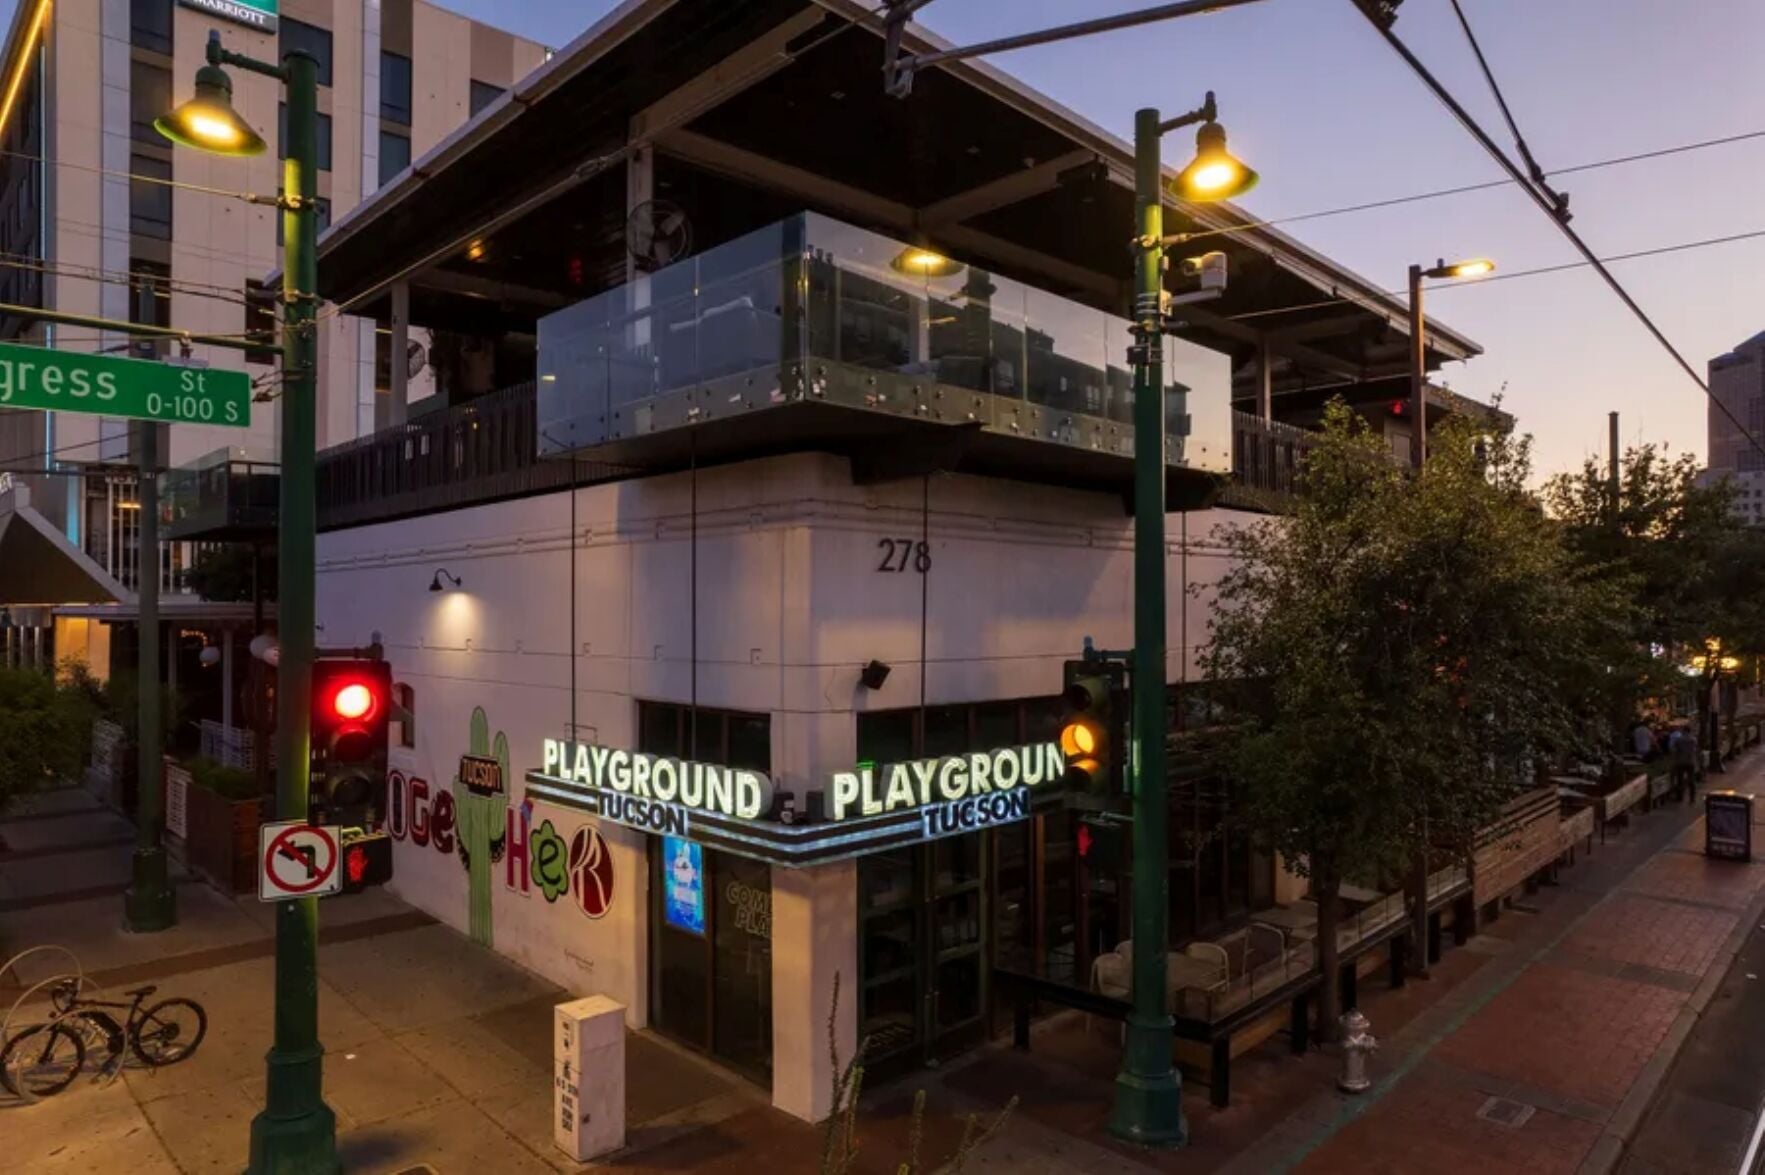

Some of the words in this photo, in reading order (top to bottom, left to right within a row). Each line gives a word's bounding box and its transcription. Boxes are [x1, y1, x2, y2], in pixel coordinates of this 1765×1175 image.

[196, 0, 265, 24] MARRIOTT
[181, 370, 206, 393] St
[147, 393, 213, 420] 0-100
[225, 401, 239, 422] S
[877, 538, 932, 573] 278
[543, 738, 763, 819] PLAYGROUND
[832, 742, 1065, 822] PLAYGROUN
[599, 792, 685, 836] TUCSON
[924, 789, 1030, 835] TUCSON
